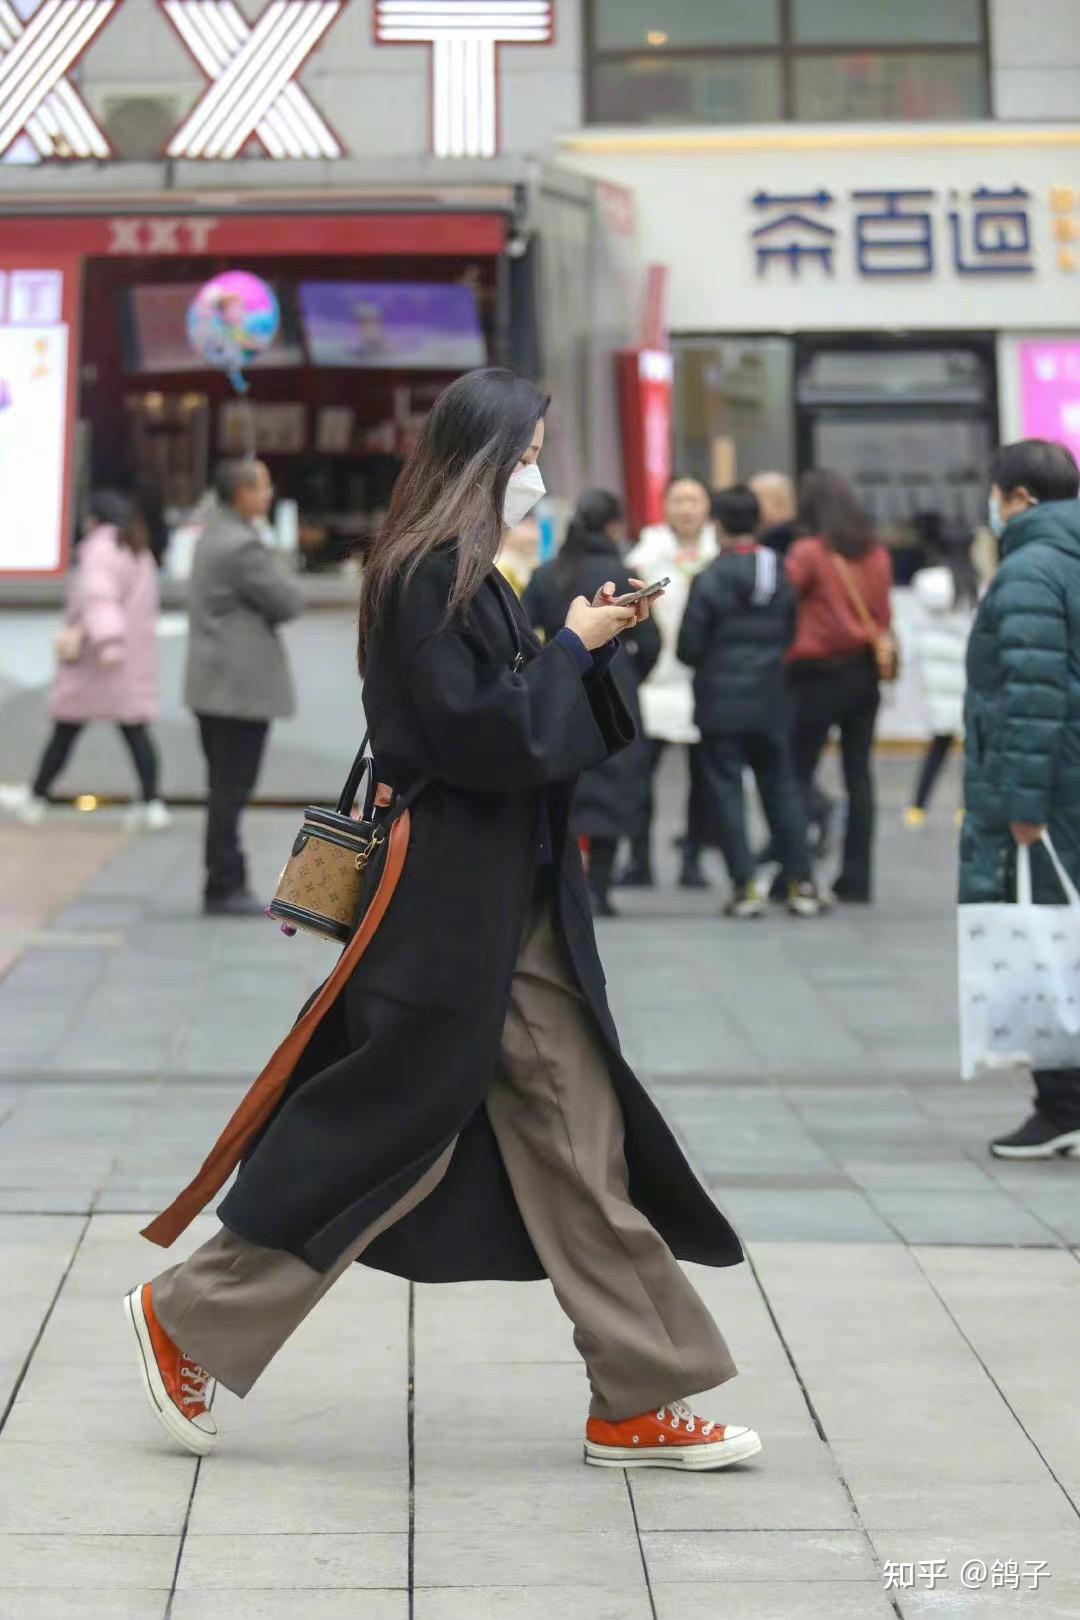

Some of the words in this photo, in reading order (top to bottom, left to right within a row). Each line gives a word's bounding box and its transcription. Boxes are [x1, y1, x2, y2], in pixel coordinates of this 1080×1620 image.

[108, 217, 219, 254] XXT
[751, 184, 1035, 277] 茶百道
